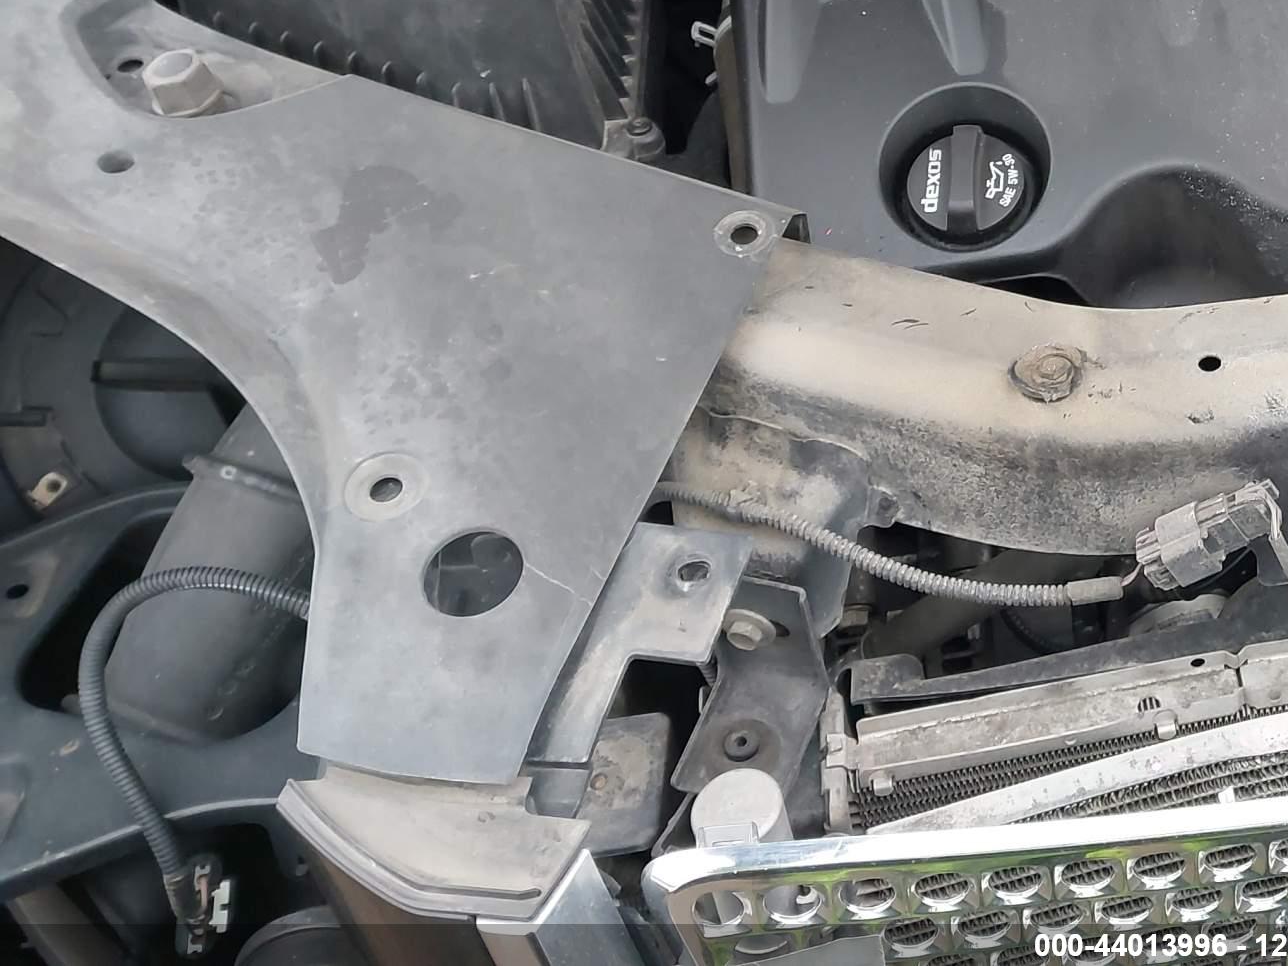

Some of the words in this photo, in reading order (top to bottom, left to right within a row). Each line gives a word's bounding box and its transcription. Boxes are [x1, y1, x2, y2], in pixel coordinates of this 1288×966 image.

[920, 148, 942, 213] dexos
[1002, 153, 1019, 185] 5W-30
[999, 186, 1016, 207] SAE
